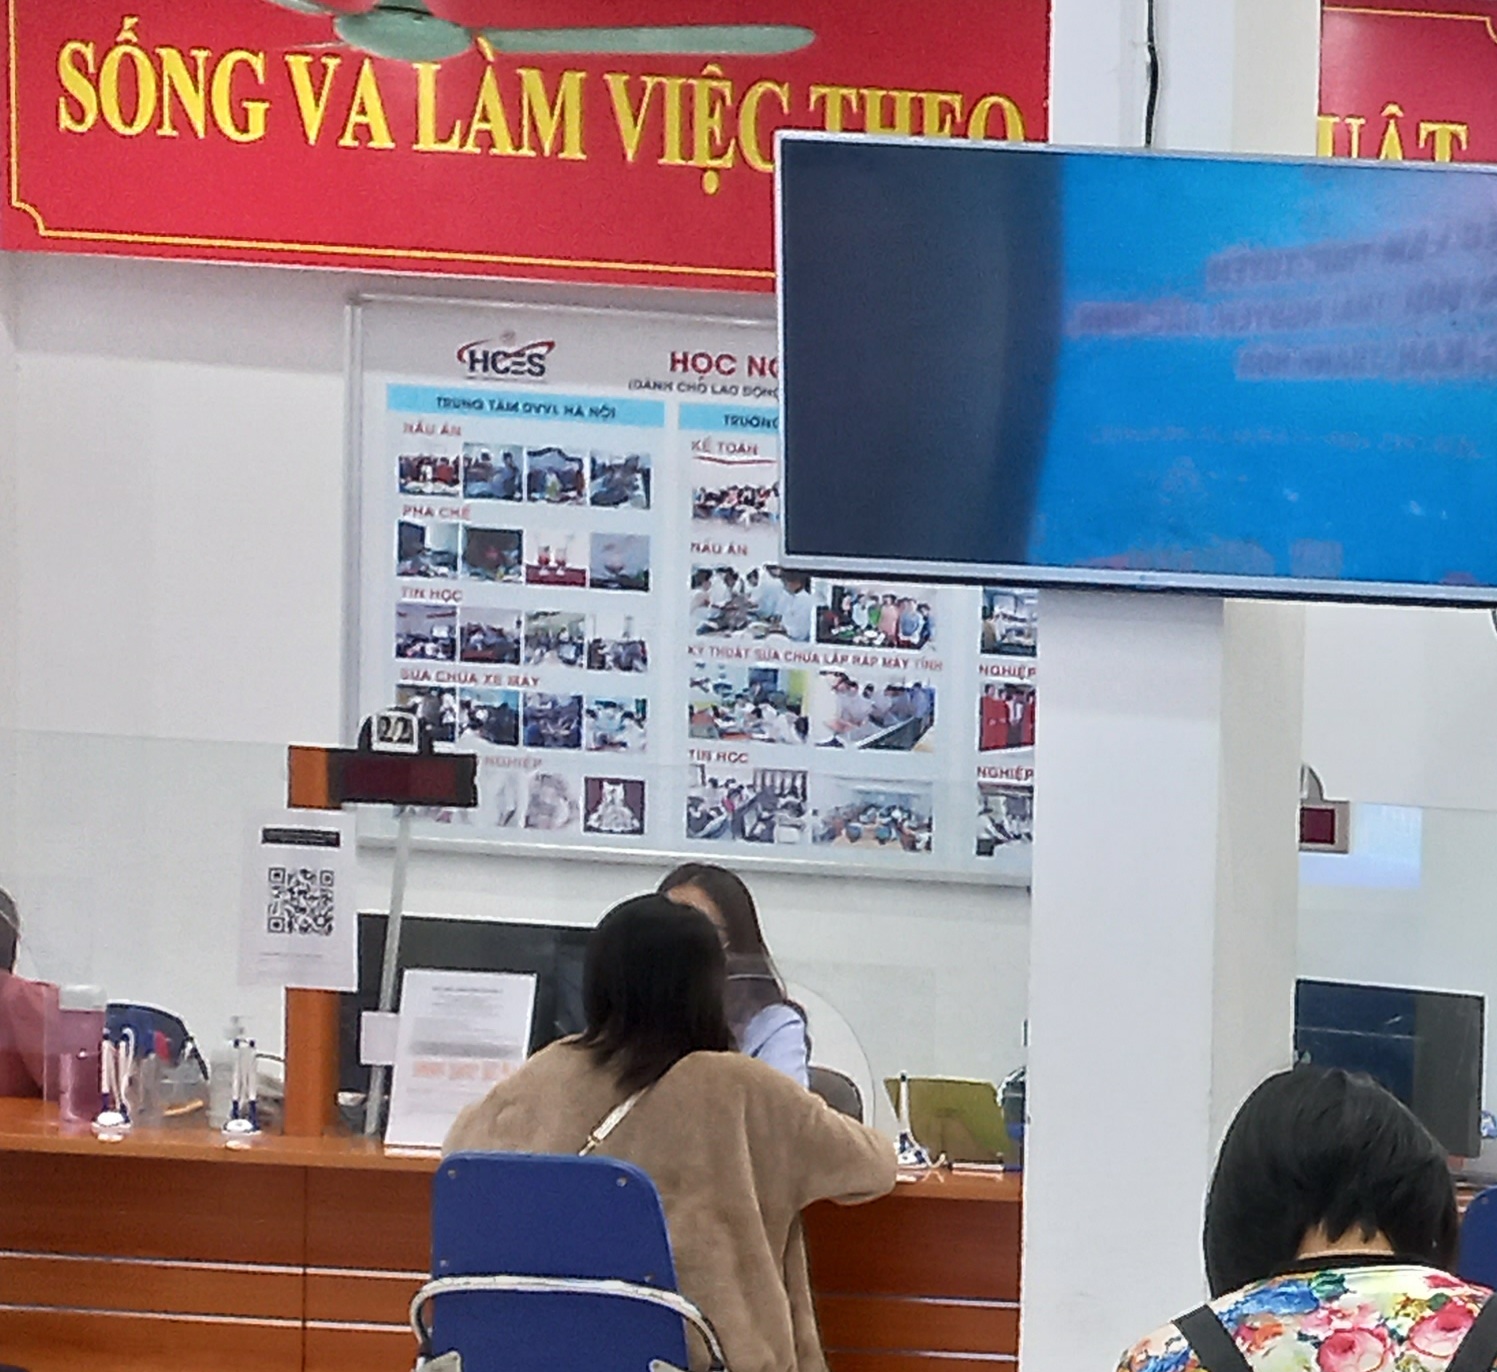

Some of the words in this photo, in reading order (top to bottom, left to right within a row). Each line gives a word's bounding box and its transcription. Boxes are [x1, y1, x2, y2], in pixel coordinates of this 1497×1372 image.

[57, 16, 269, 143] SỐNG
[412, 36, 588, 160] LÀM
[605, 63, 790, 195] VIỆC
[469, 350, 546, 376] HCES
[379, 716, 412, 743] 22
